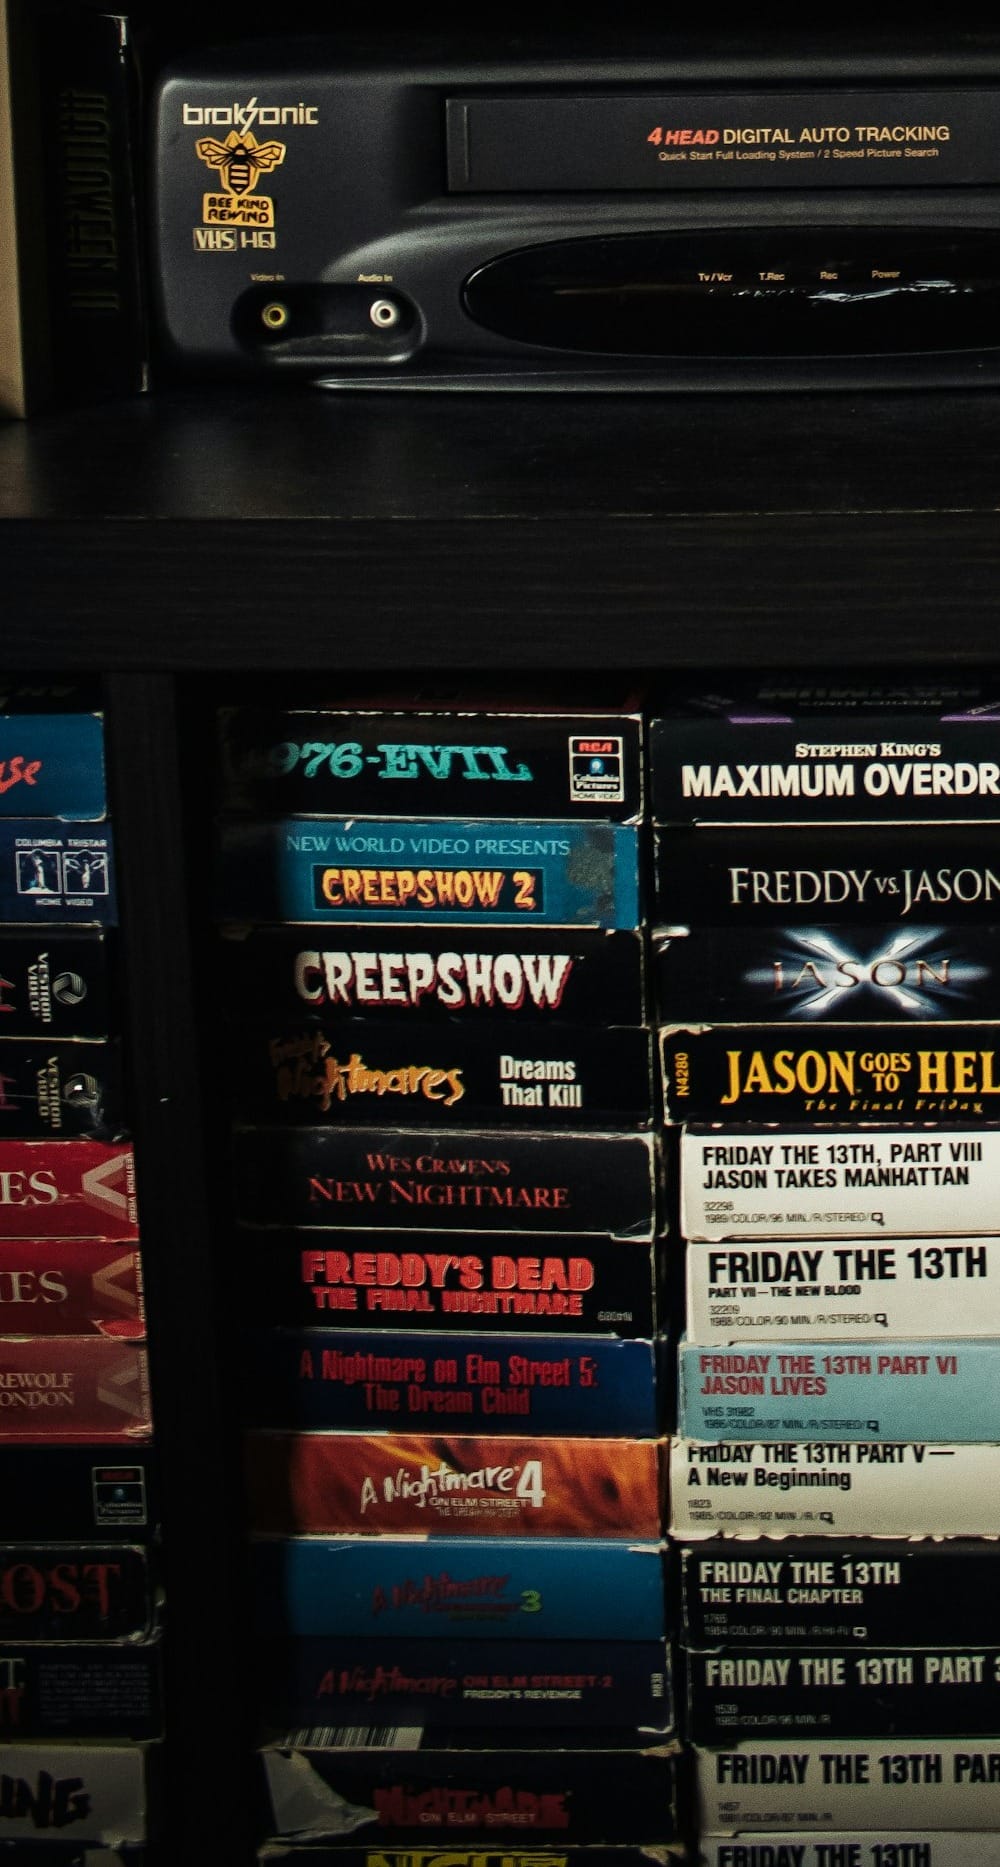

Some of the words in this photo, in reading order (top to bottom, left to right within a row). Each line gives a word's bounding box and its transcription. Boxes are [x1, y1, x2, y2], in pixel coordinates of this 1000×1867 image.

[648, 127, 662, 145] 4
[665, 130, 719, 145] HEAD
[723, 127, 794, 144] DIGITAL
[800, 126, 850, 143] AUTO
[855, 125, 950, 142] TRACKING
[659, 150, 686, 162] Quick
[688, 151, 712, 161] Start
[716, 150, 734, 161] Full
[736, 150, 777, 162] Loading
[780, 149, 814, 162] System
[824, 149, 831, 160] 2
[833, 148, 865, 161] Speed
[868, 148, 902, 159] Picture
[905, 147, 939, 158] Search
[208, 197, 233, 210] BEE
[236, 198, 269, 211] KIND
[207, 208, 270, 223] REWIND
[195, 230, 234, 250] VHS
[240, 231, 276, 250] HQ
[358, 273, 381, 283] Audio
[820, 270, 839, 281] Rec
[871, 269, 901, 280] Power
[578, 740, 613, 754] RCA
[794, 743, 877, 758] STEPHEN
[879, 742, 942, 757] KING'S
[682, 764, 855, 798] MAXIMUM
[15, 838, 64, 848] COLUMBIA
[67, 838, 108, 848] TRISTAR
[287, 836, 329, 852] NEW
[335, 837, 405, 854] WORLD
[410, 838, 470, 854] VIDEO
[475, 839, 570, 856] PRESENTS
[321, 869, 505, 909] CREEPSHOW
[512, 871, 538, 911] 2
[66, 898, 95, 908] VIDEO
[38, 951, 52, 1024] VESTRON
[293, 951, 577, 1011] CREEPSHOW
[500, 1056, 577, 1082] Dreams
[676, 1052, 690, 1098] N4280
[720, 1050, 857, 1105] JASON
[859, 1052, 913, 1072] GOES
[872, 1072, 901, 1093] TO
[502, 1083, 543, 1108] That
[548, 1083, 582, 1109] Kill
[804, 1099, 839, 1112] The
[849, 1098, 905, 1111] Final
[914, 1098, 985, 1113] Friday
[703, 1146, 774, 1166] FRIDAY
[781, 1145, 817, 1165] THE
[827, 1144, 882, 1167] 13TH,
[889, 1143, 942, 1163] PART
[950, 1142, 983, 1162] VIII
[703, 1169, 768, 1190] JASON
[774, 1168, 838, 1188] TAKES
[844, 1166, 971, 1187] MANHATTAN
[307, 1177, 382, 1203] NEW
[388, 1179, 571, 1209] NIGHTMARE
[301, 1249, 484, 1291] FREDDY'S
[489, 1254, 597, 1292] DEAD
[708, 1250, 824, 1284] FRIDAY
[834, 1249, 897, 1281] THE
[907, 1247, 988, 1279] 13TH
[699, 1355, 771, 1376] FRIDAY
[781, 1355, 816, 1375] THE
[821, 1355, 873, 1375] 13TH
[877, 1355, 931, 1375] PART
[937, 1355, 958, 1375] VI
[700, 1376, 765, 1397] JASON
[770, 1377, 829, 1397] LIVES
[364, 1383, 401, 1412] The
[407, 1385, 474, 1415] Dream
[482, 1387, 532, 1416] Child
[687, 1468, 701, 1487] A
[707, 1467, 748, 1487] New
[754, 1468, 852, 1491] Beginning
[699, 1561, 783, 1585] FRIDAY
[790, 1562, 836, 1585] THE
[842, 1561, 902, 1585] 13TH
[699, 1587, 732, 1605] THE
[735, 1588, 784, 1605] FINAL
[787, 1588, 864, 1606] CHAPTER
[705, 1659, 792, 1687] FRIDAY
[798, 1658, 847, 1685] THE
[855, 1658, 914, 1685] 13TH
[923, 1656, 987, 1684] PART
[462, 1689, 522, 1700] FREDDY'S
[525, 1689, 583, 1700] REVENGE
[418, 1813, 442, 1824] ON
[447, 1813, 476, 1824] ELM
[485, 1812, 537, 1824] STREET
